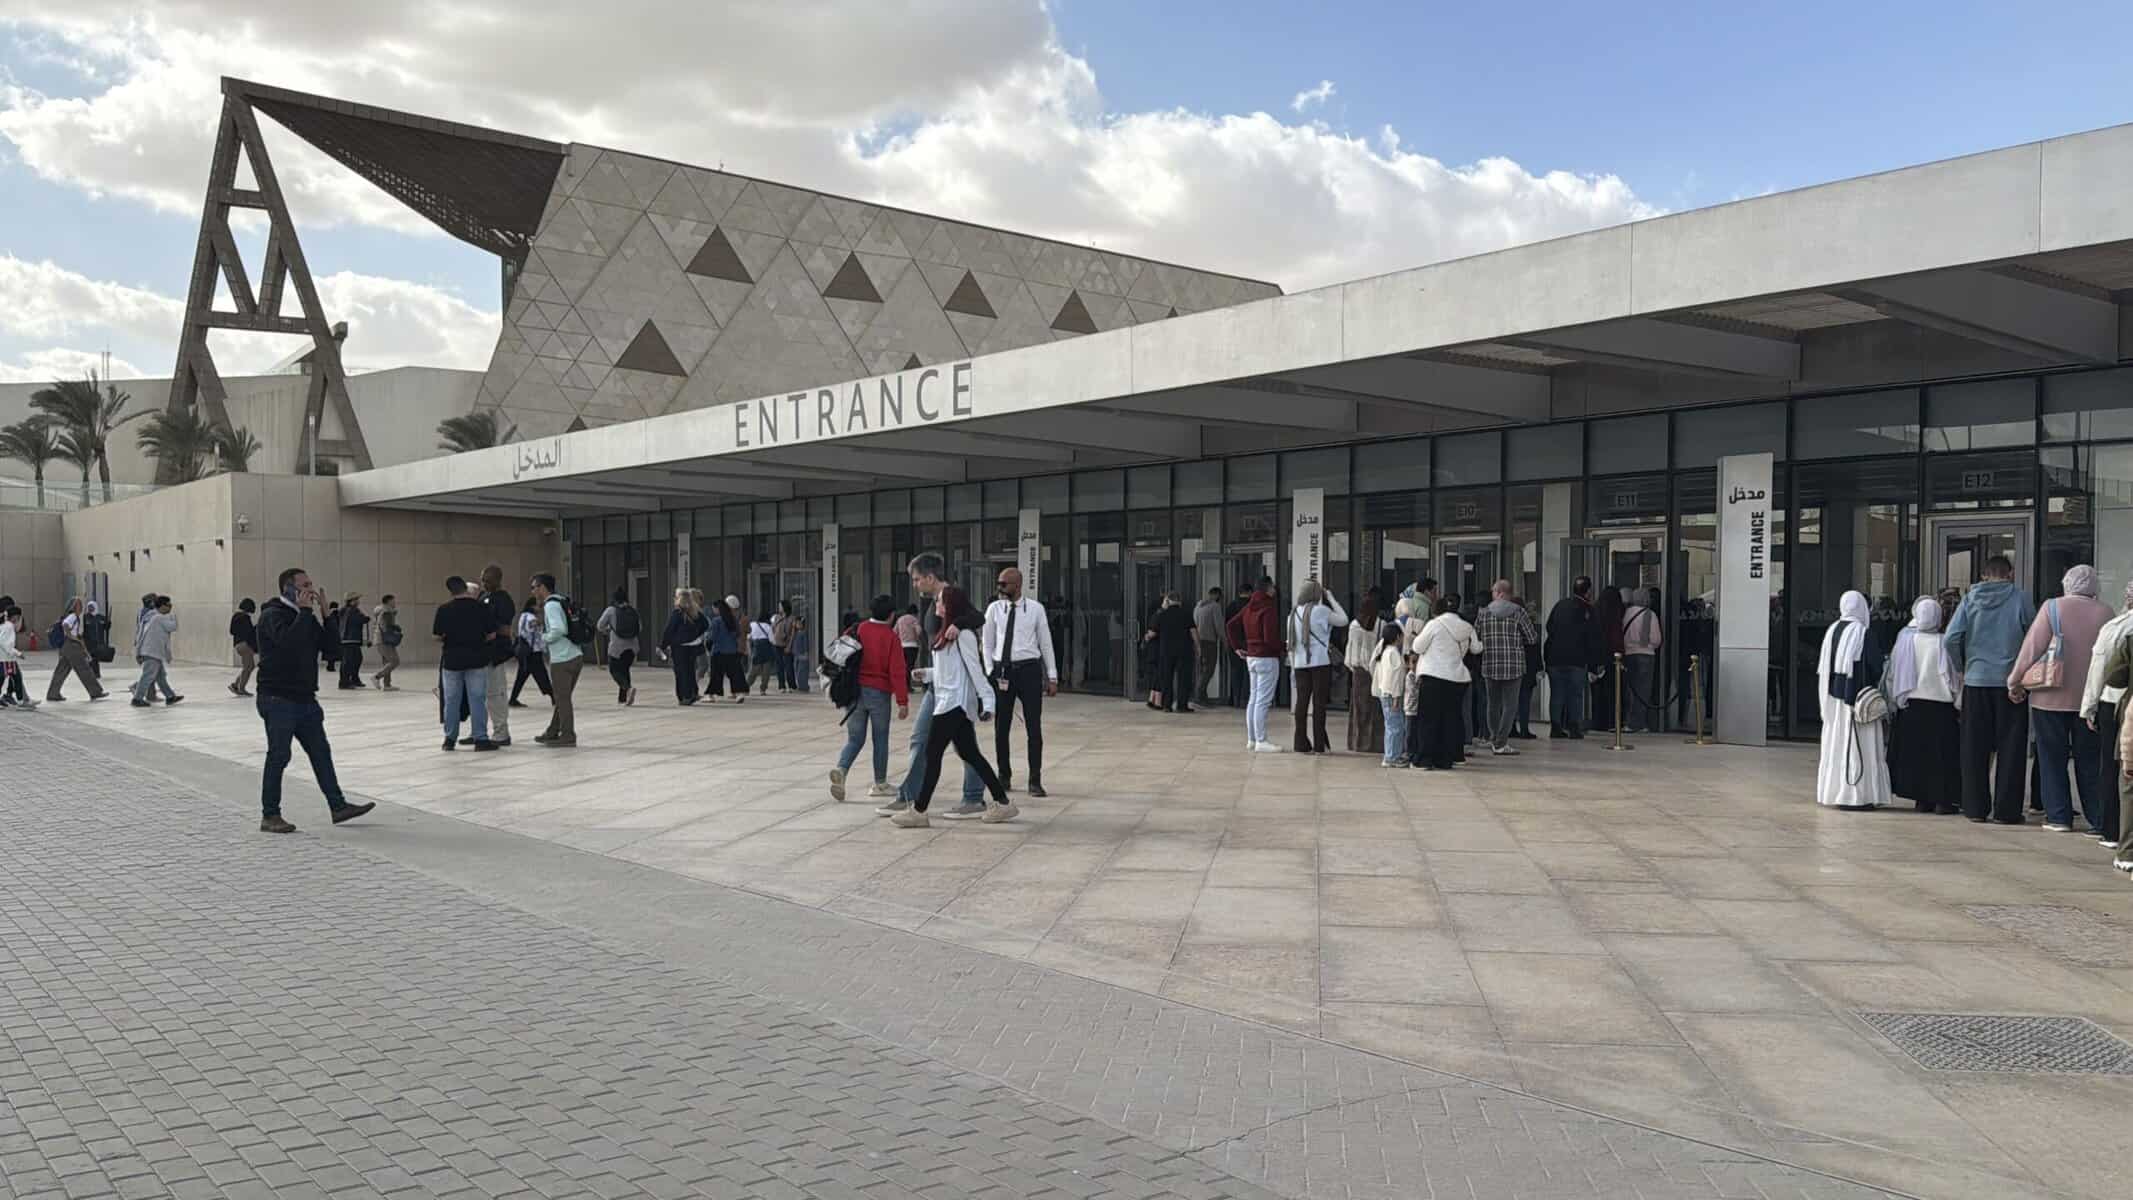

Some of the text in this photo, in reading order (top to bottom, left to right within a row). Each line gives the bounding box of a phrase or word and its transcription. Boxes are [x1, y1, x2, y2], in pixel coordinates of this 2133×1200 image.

[736, 363, 972, 447] ENTRANCE
[513, 440, 562, 480] المدخل
[1730, 486, 1765, 505] مدخل
[1963, 474, 1992, 489] E12
[1617, 495, 1636, 507] E11
[1297, 514, 1319, 527] مدخل
[1310, 533, 1319, 582] NTRANCE
[1750, 511, 1765, 578] ENTRANCE
